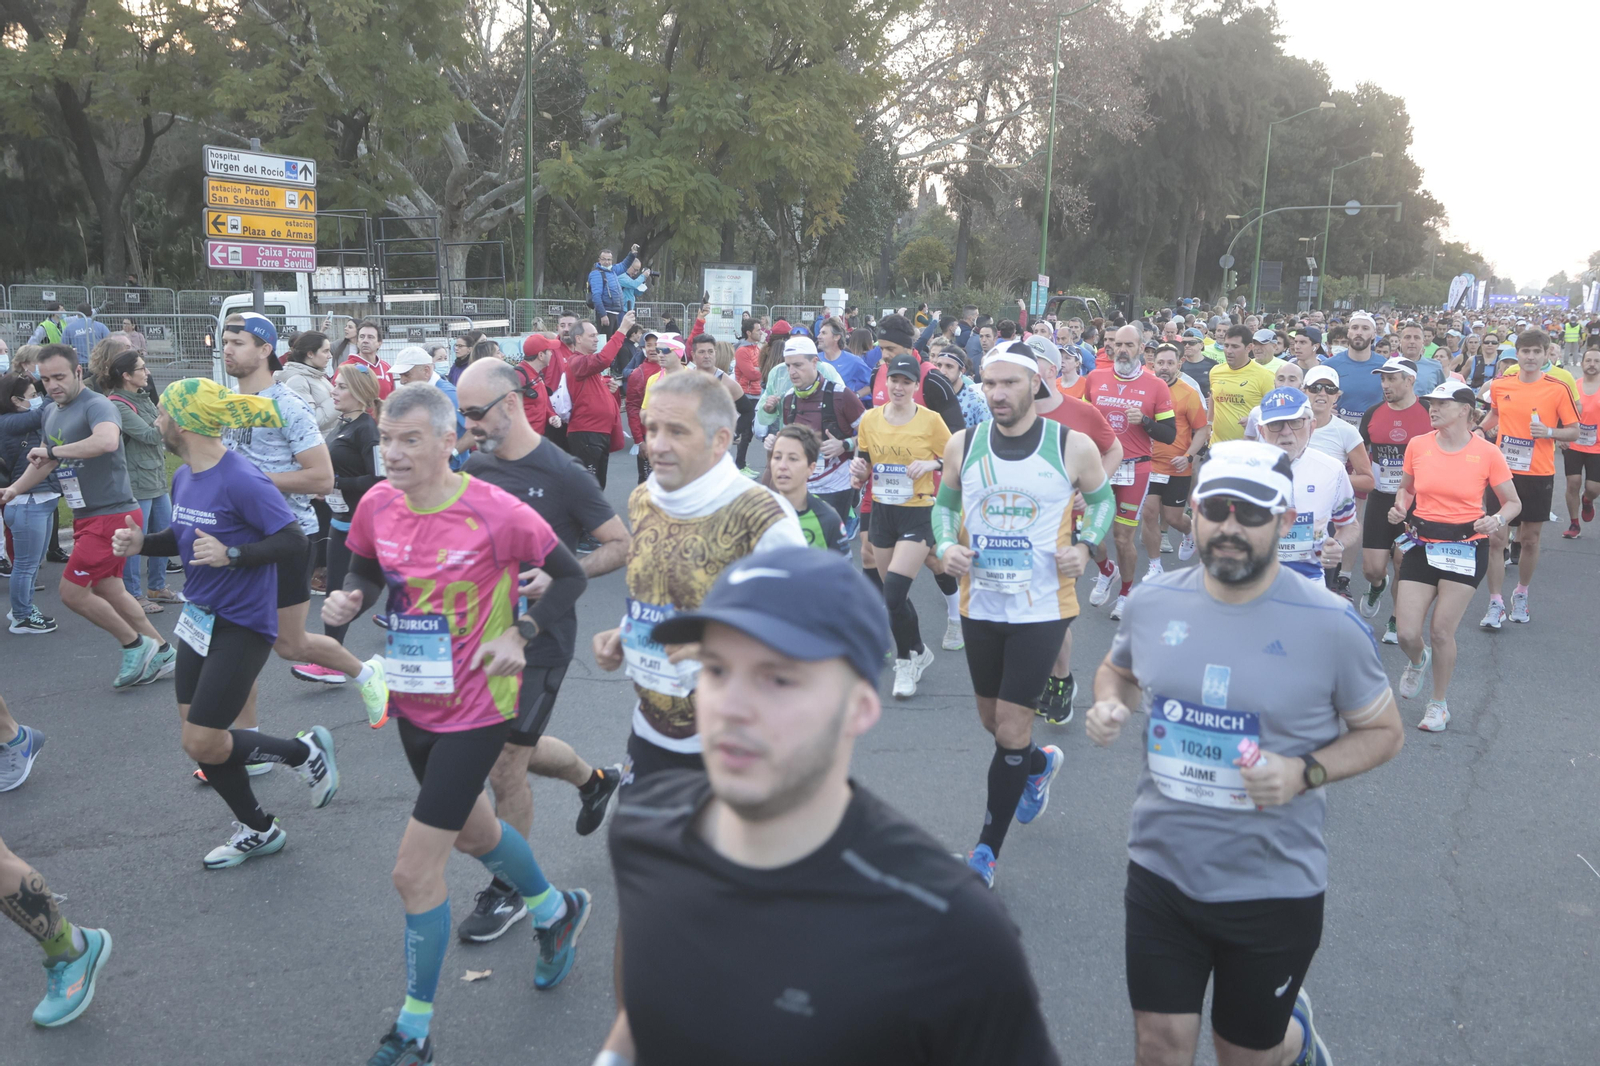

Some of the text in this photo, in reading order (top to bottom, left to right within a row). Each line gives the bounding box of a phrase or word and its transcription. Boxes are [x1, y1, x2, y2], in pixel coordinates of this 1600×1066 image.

[210, 151, 240, 162] hospital
[210, 160, 240, 172] Virgen
[243, 164, 257, 174] del
[210, 185, 270, 196] estación Prado
[211, 193, 276, 208] San Sebastián
[285, 220, 313, 228] estación
[242, 226, 313, 240] Plaza de Armas
[258, 246, 313, 258] Caixa Forum
[256, 257, 313, 268] Torre Sevilla
[1508, 438, 1531, 446] ZURICH
[985, 504, 1033, 519] ALCER
[195, 516, 217, 525] STUDIO
[989, 538, 1024, 548] ZURICH
[1441, 547, 1462, 556] 11329
[988, 558, 1014, 567] 11190
[986, 571, 1004, 579] DAVID
[399, 619, 439, 630] ZURICH
[1185, 708, 1244, 730] ZURICH
[1180, 739, 1222, 760] 10249
[1180, 765, 1216, 782] JAIME
